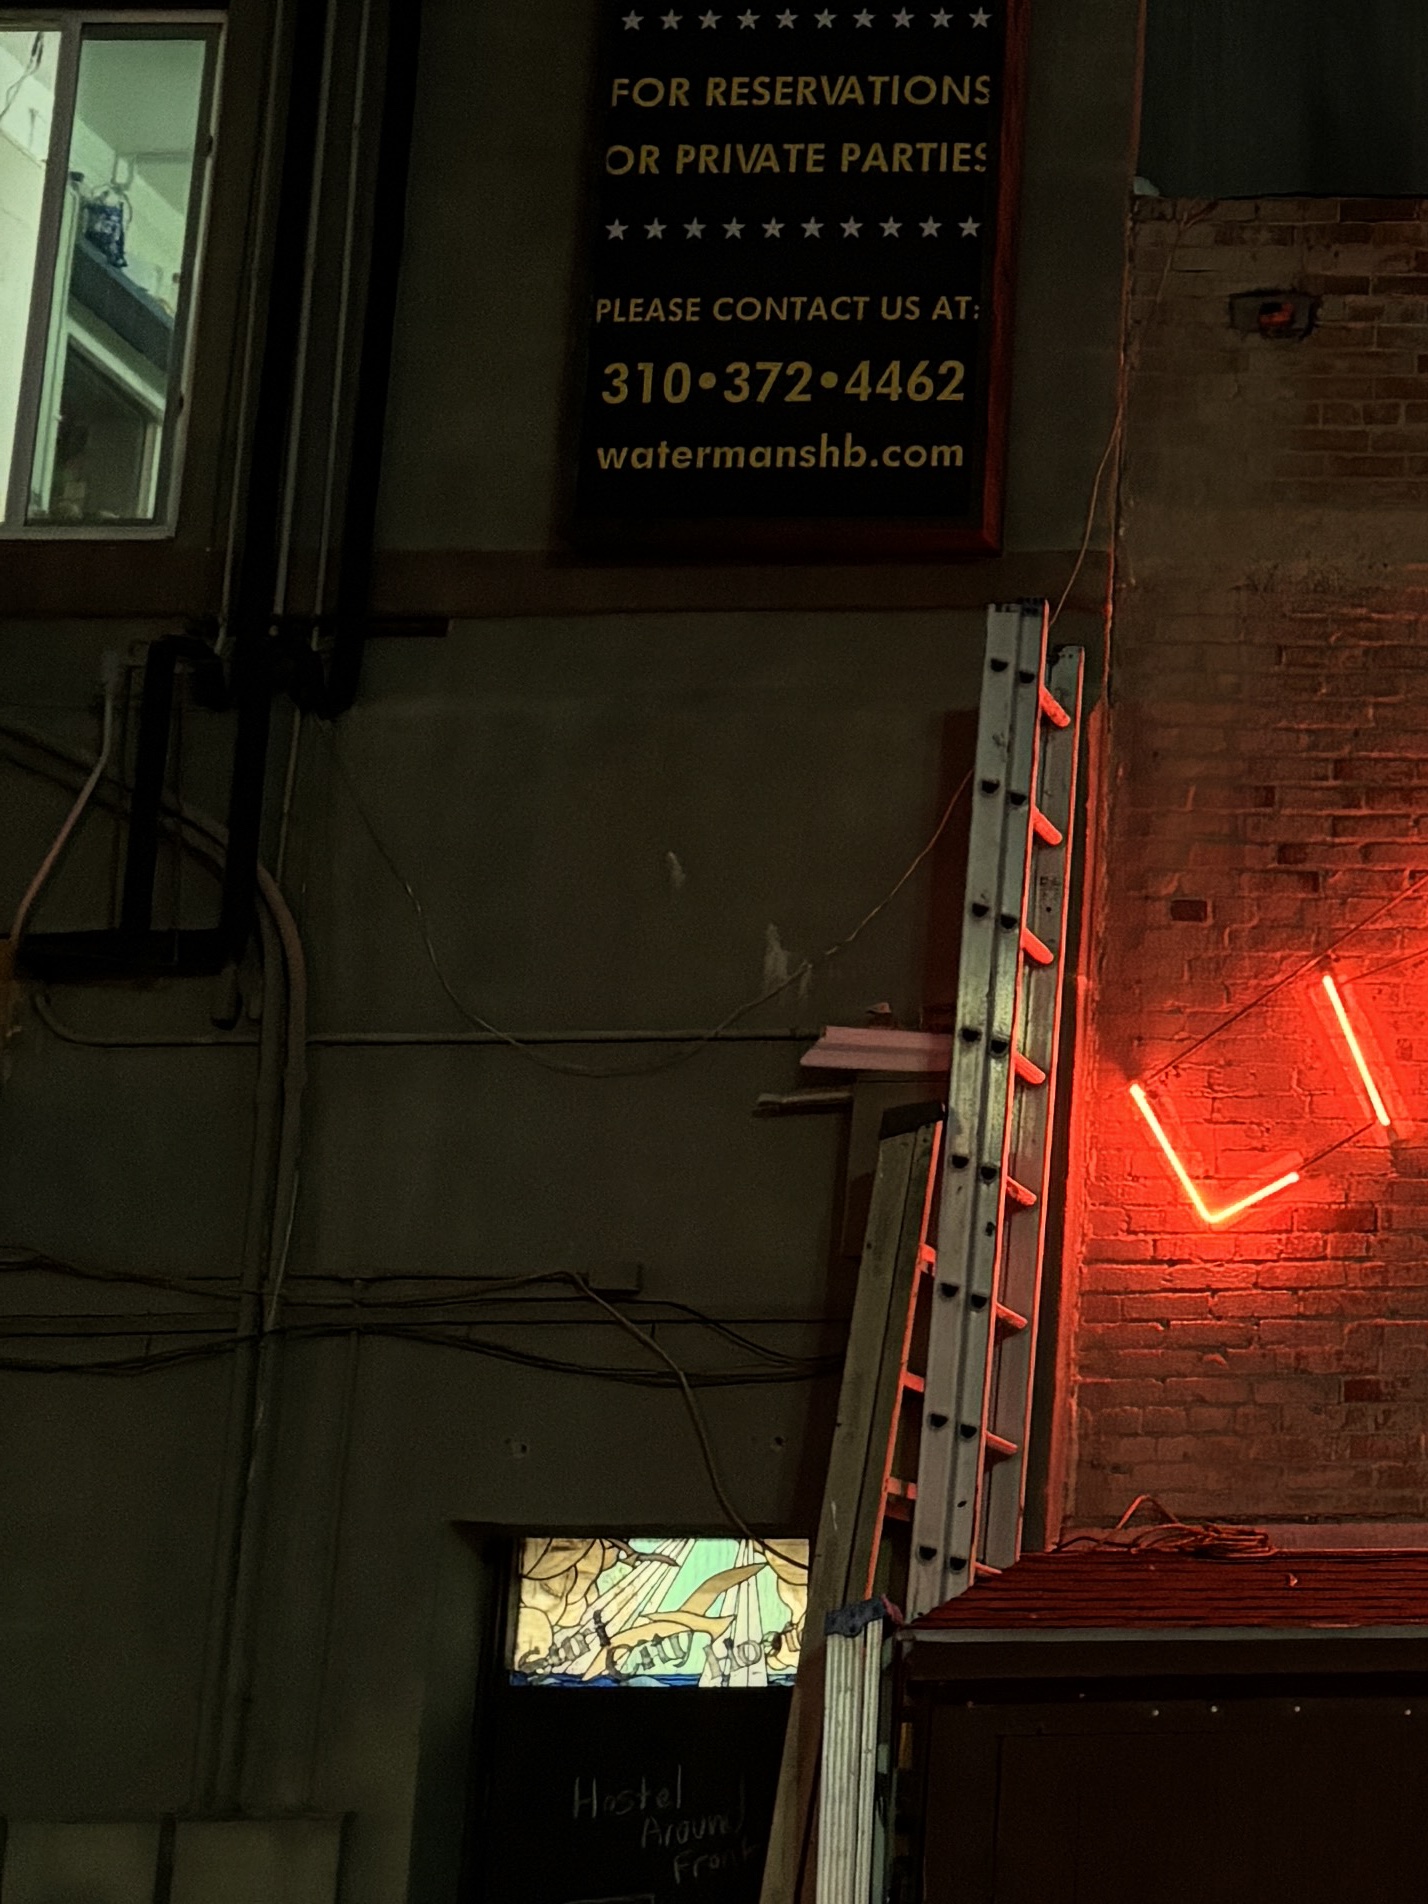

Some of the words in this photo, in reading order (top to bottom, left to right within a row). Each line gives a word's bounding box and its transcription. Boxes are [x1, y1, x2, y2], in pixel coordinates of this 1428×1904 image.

[611, 76, 691, 107] FOR
[705, 73, 991, 106] RESERVATIONS
[605, 144, 660, 176] OR
[675, 142, 826, 175] PRIVATE
[840, 141, 987, 173] PARTIES
[595, 296, 700, 323] PLEASE
[712, 295, 871, 322] CONTACT
[880, 295, 921, 320] US
[931, 295, 981, 320] AT:
[596, 432, 964, 470] watermanshb.com
[572, 1763, 683, 1820] Hostel
[640, 1772, 746, 1849] Around
[672, 1835, 761, 1885] Front
